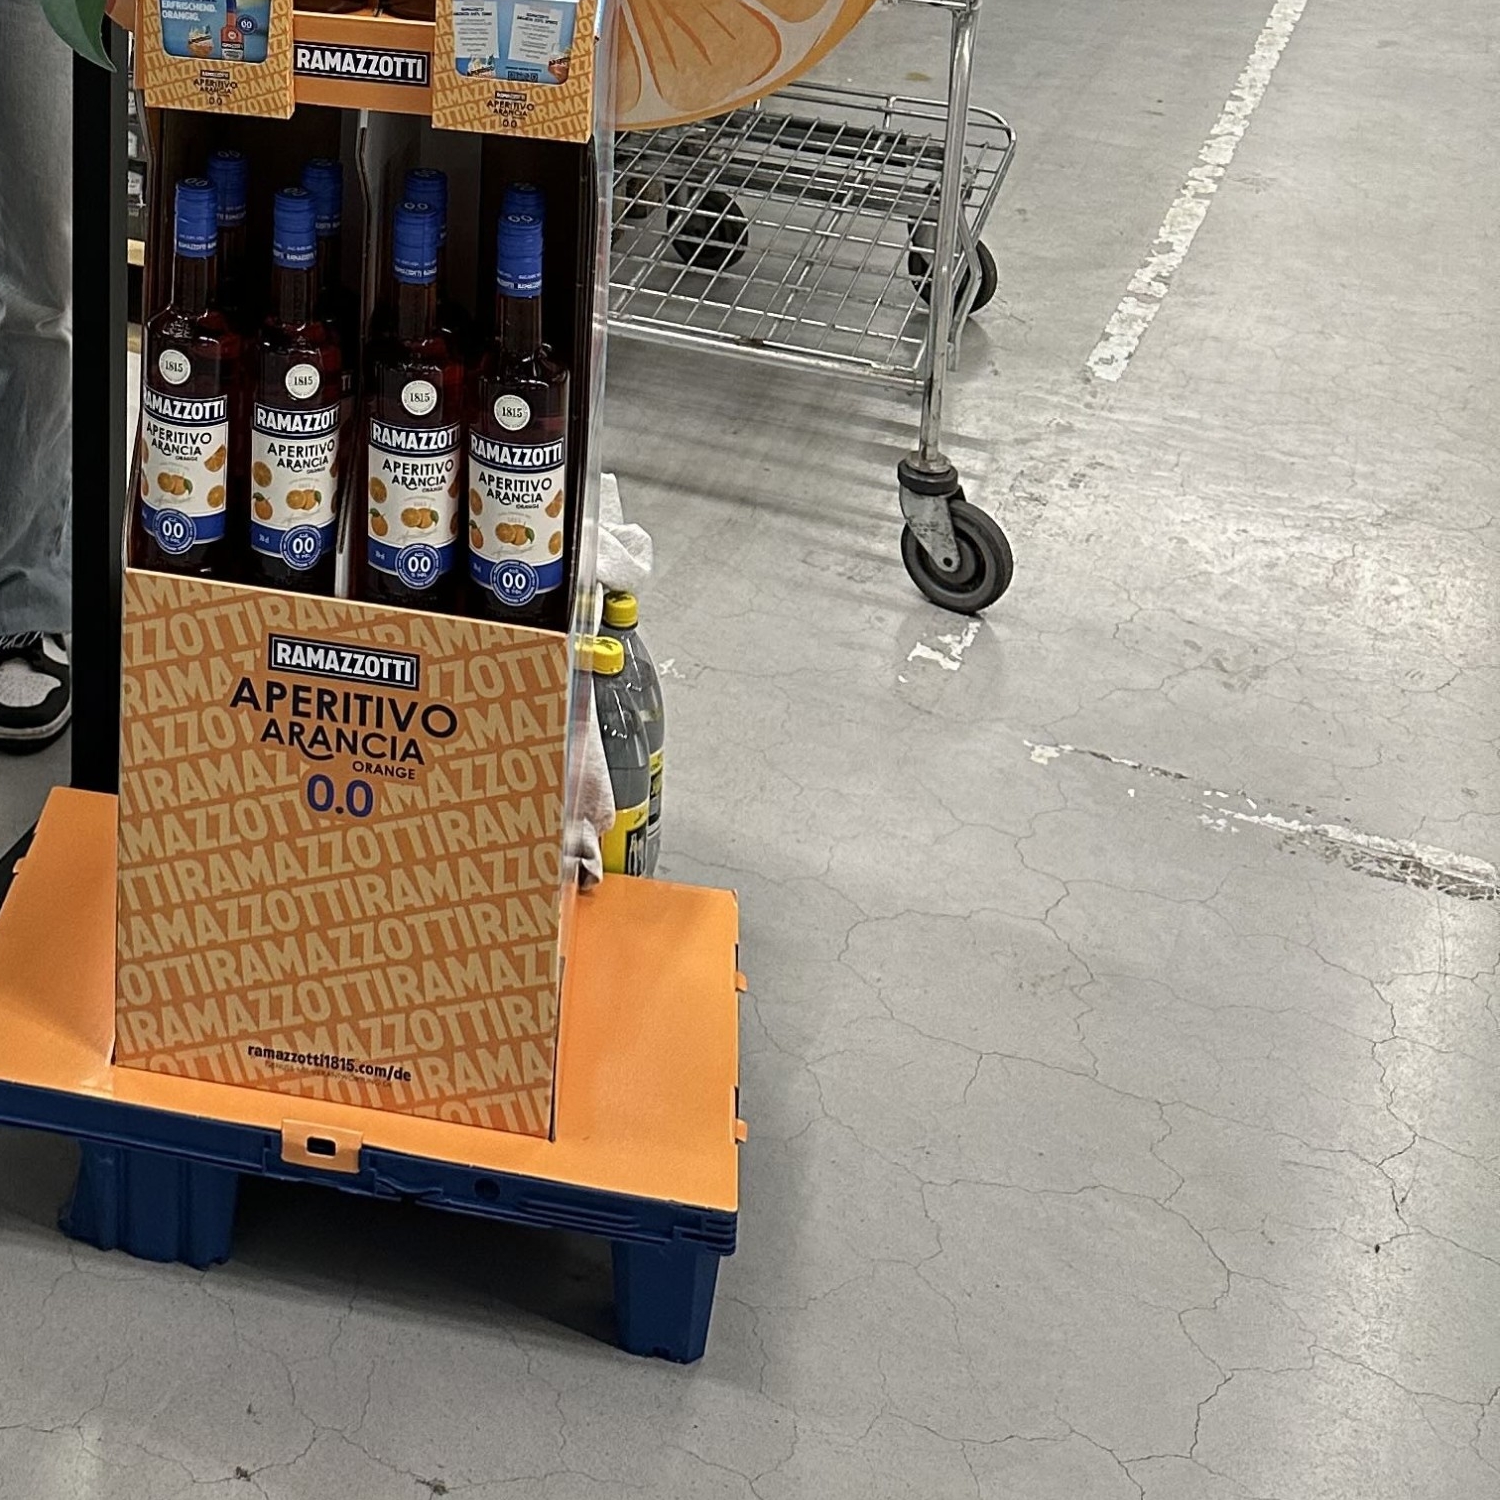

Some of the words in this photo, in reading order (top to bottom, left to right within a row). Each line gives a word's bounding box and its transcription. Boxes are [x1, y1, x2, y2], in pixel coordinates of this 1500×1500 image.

[297, 48, 423, 80] RAMAZZOTTI
[486, 99, 535, 112] APERITIVO
[165, 359, 184, 373] 1815
[293, 375, 313, 386] 1815
[409, 391, 430, 402] 1815
[257, 407, 339, 432] RAMAZZOT
[501, 406, 523, 419] 1815
[146, 420, 212, 445] APERITIVO
[151, 438, 202, 456] ARANCIA
[267, 439, 335, 458] APERITIVO
[471, 436, 563, 467] RAMAZZOTTI
[276, 455, 329, 473] ARANCIA
[382, 458, 454, 476] APERITIVO
[391, 474, 447, 491] ARANCIA
[478, 472, 552, 491] APERITIVO
[486, 489, 543, 506] ARANCIA
[276, 643, 412, 683] RAMAZZOTTI
[230, 677, 458, 739] APERITIVO
[260, 716, 425, 766] ARANCIA
[352, 760, 416, 781] ORANGE
[306, 773, 374, 818] 0.0
[247, 1045, 412, 1083] ramazzotti1815.com/de
